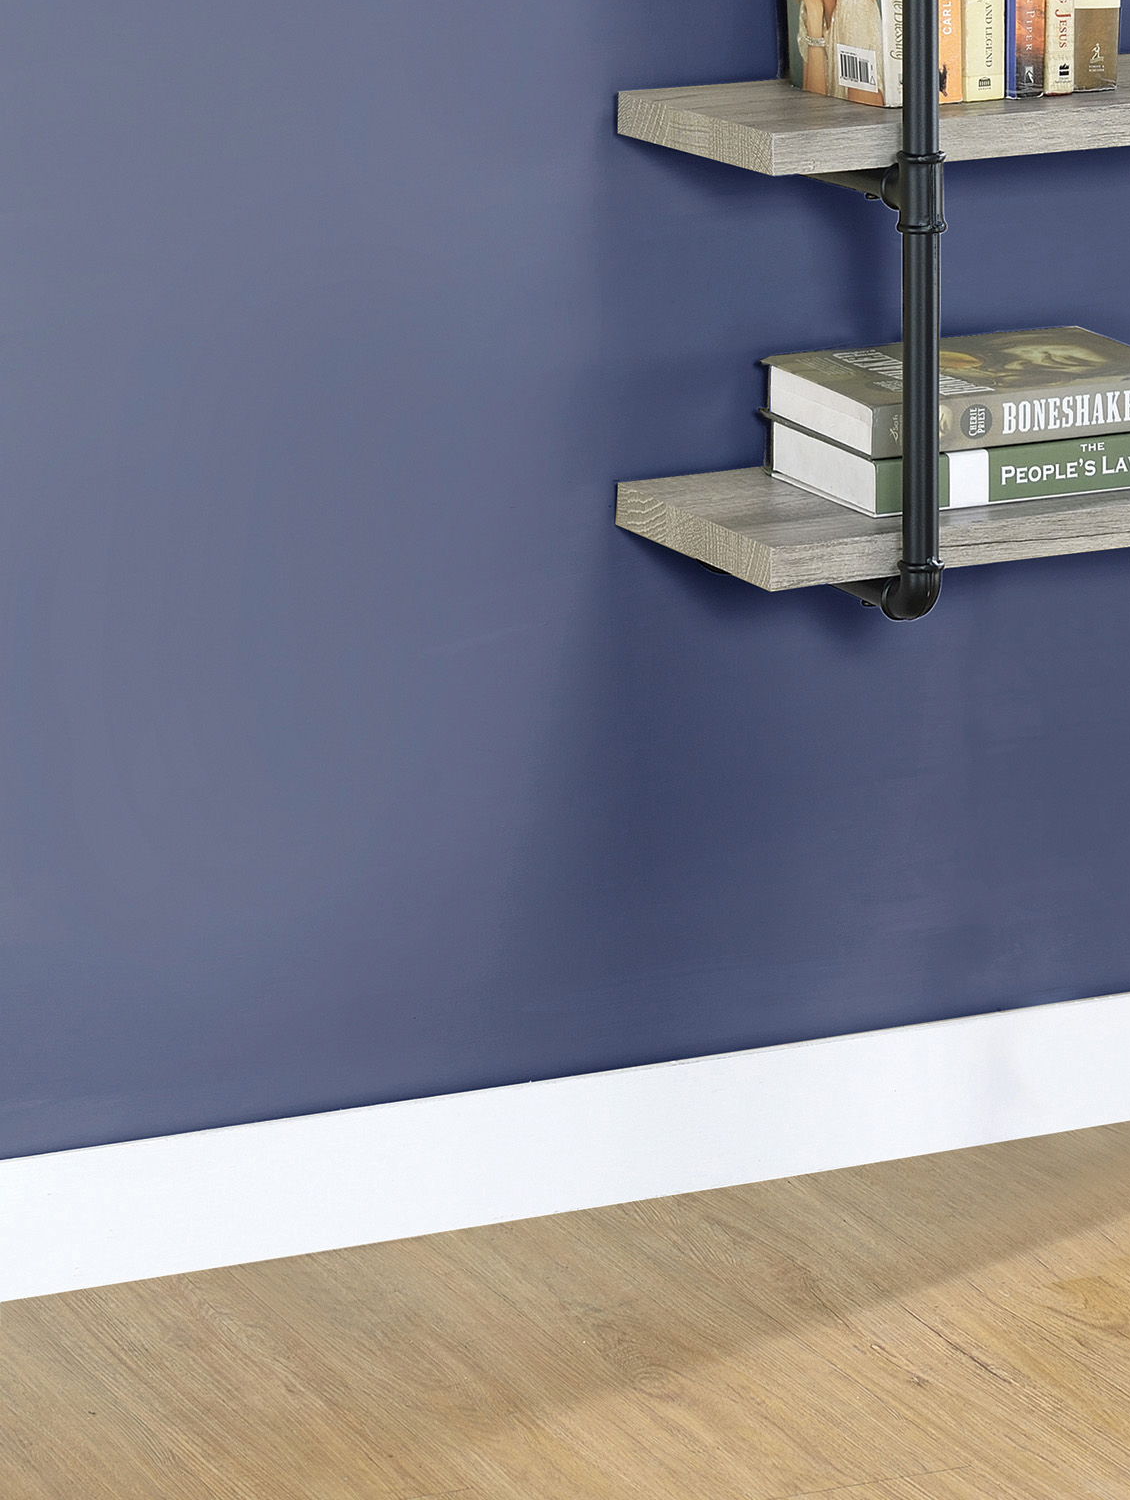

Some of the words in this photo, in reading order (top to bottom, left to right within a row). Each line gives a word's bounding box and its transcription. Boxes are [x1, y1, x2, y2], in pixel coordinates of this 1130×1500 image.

[1024, 10, 1035, 52] PIPER
[1055, 9, 1071, 48] JESUS
[968, 406, 977, 436] CHERIE
[978, 406, 986, 434] PRIEST
[1080, 442, 1105, 452] THE
[1001, 458, 1096, 486] PEOPLE'S
